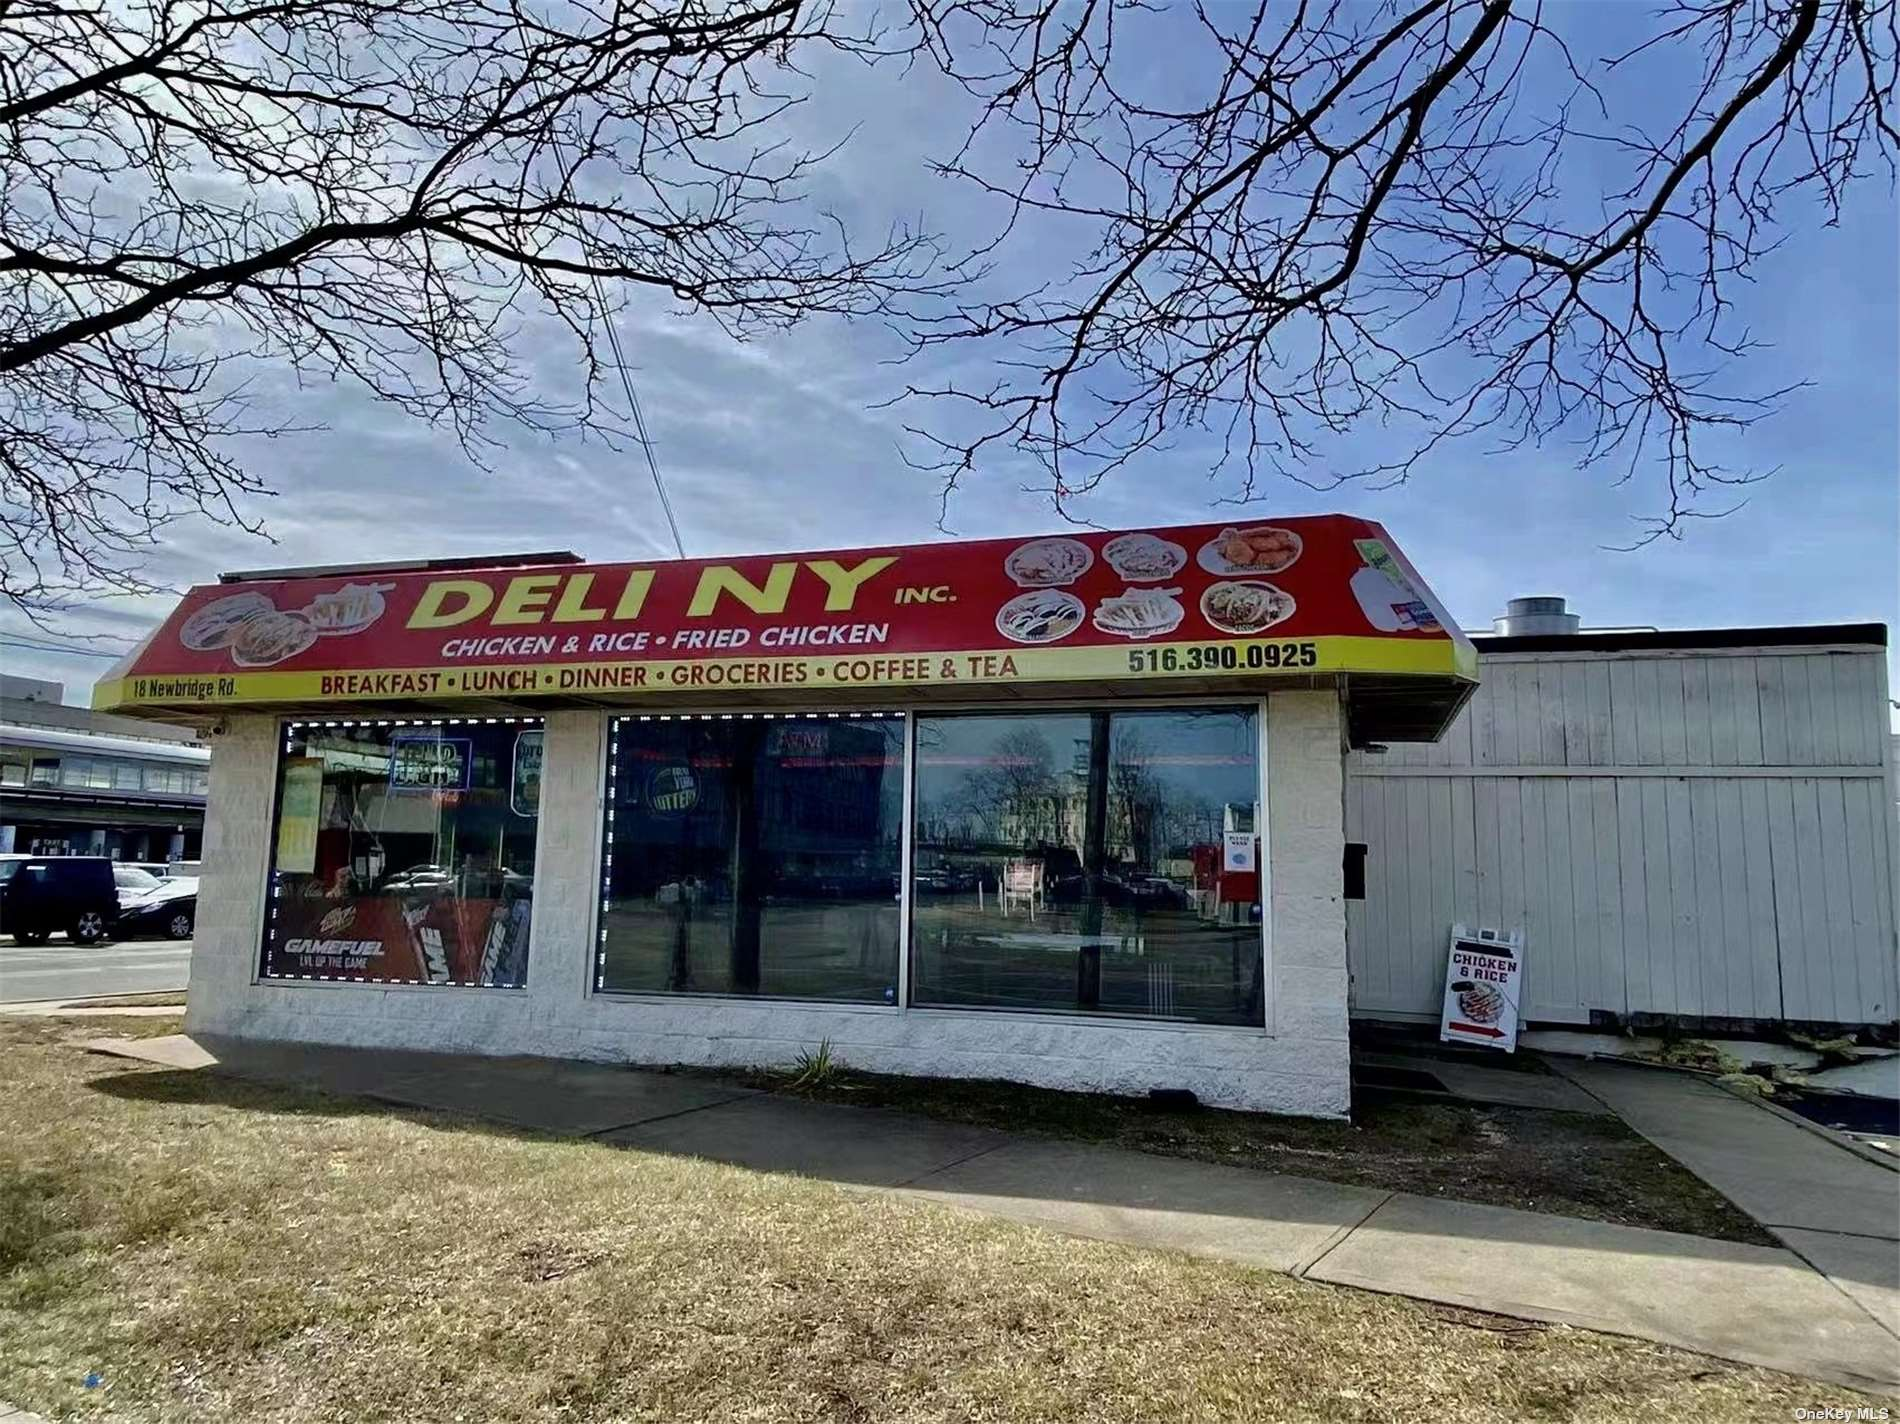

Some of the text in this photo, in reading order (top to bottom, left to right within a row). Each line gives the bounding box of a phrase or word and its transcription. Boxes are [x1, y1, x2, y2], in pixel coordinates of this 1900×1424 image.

[405, 556, 957, 630] DELI NY INC.
[441, 622, 889, 658] CHICKEN & RICE FRIED CHICKEN
[1128, 642, 1317, 673] 516.390.0925
[134, 677, 238, 701] 18 Newbridge Rd.
[320, 655, 1019, 696] BREAKFAST LUNCH DINNER GROCERIES COFFEE & TEA
[1452, 953, 1518, 973] CHICKEN
[1459, 966, 1509, 984] & RICE
